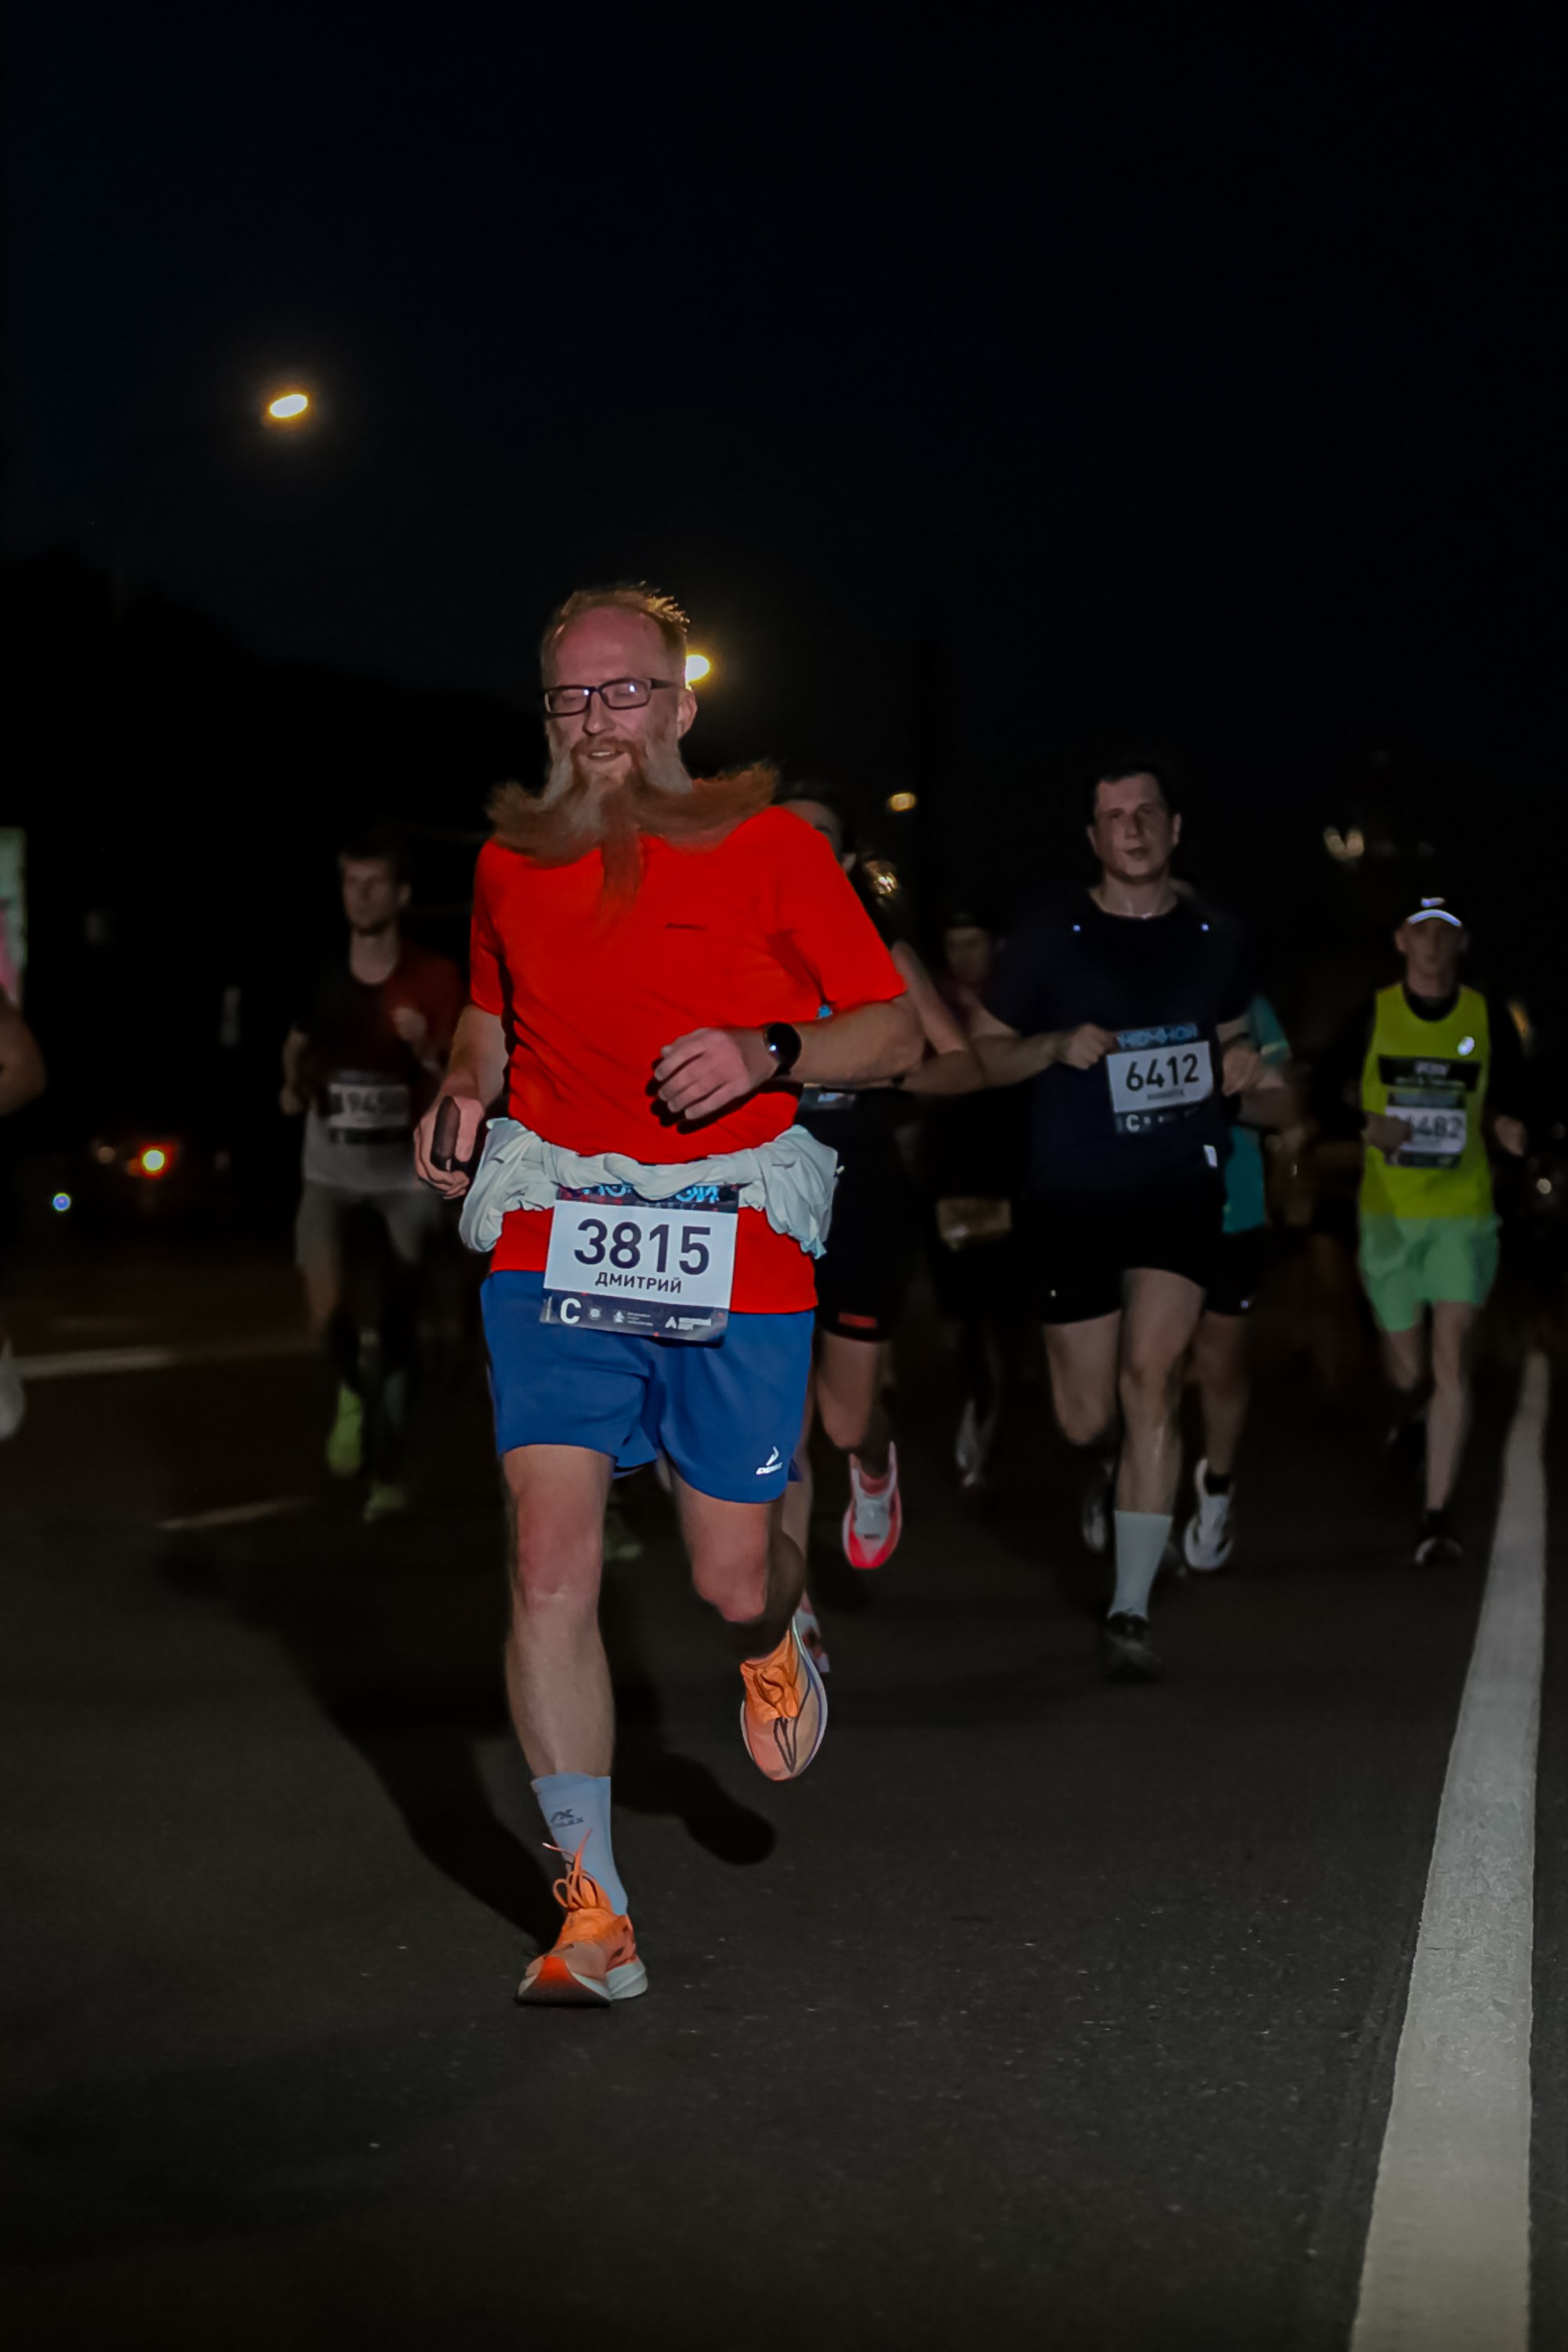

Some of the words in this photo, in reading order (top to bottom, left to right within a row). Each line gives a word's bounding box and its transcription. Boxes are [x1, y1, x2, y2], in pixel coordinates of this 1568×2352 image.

[1126, 1053, 1200, 1091] 6412
[574, 1218, 710, 1275] 3815
[596, 1272, 681, 1294] ДМИТРИЙ
